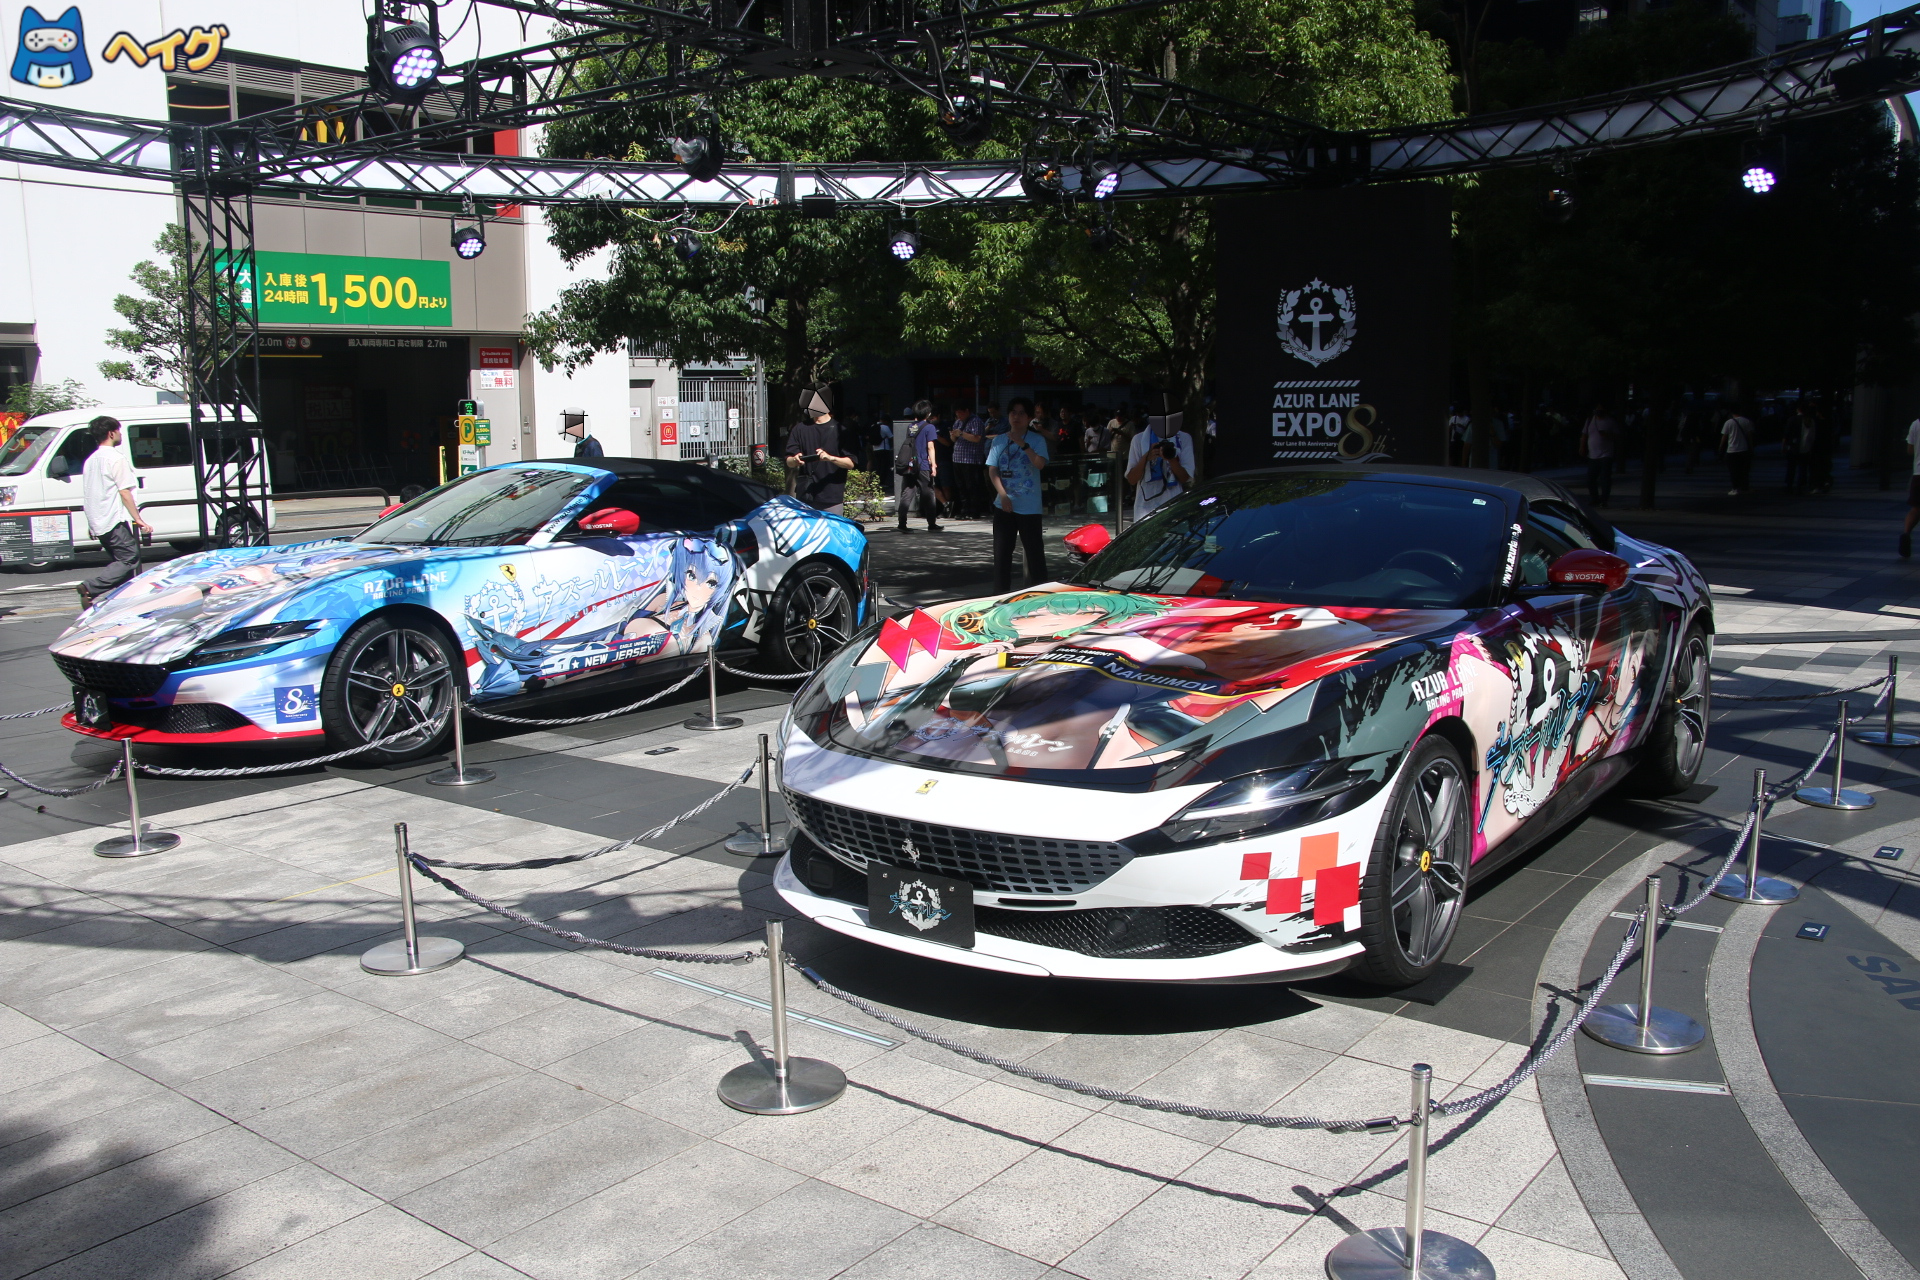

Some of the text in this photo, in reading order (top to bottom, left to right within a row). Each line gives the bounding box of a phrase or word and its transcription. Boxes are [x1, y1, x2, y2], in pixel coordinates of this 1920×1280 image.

[263, 272, 308, 287] 入庫後
[263, 290, 309, 305] 24時間
[258, 338, 283, 347] 2.0m
[397, 339, 424, 347] 高さ制限
[427, 340, 448, 348] 2.7m
[494, 377, 513, 387] 無料
[1272, 393, 1360, 408] AZUR LANE
[1272, 412, 1342, 437] EXPO
[363, 570, 448, 594] AZUR LANE
[373, 583, 439, 600] RACING PROJECT
[532, 556, 655, 628] アズールレーン
[564, 590, 638, 623] AZUR LANE
[633, 640, 647, 648] UNION
[584, 644, 656, 668] NEW JERSEY
[1103, 661, 1218, 692] NAKHIMOV
[1411, 660, 1479, 702] AZUR LANE
[1425, 681, 1475, 712] RACING PROJECT
